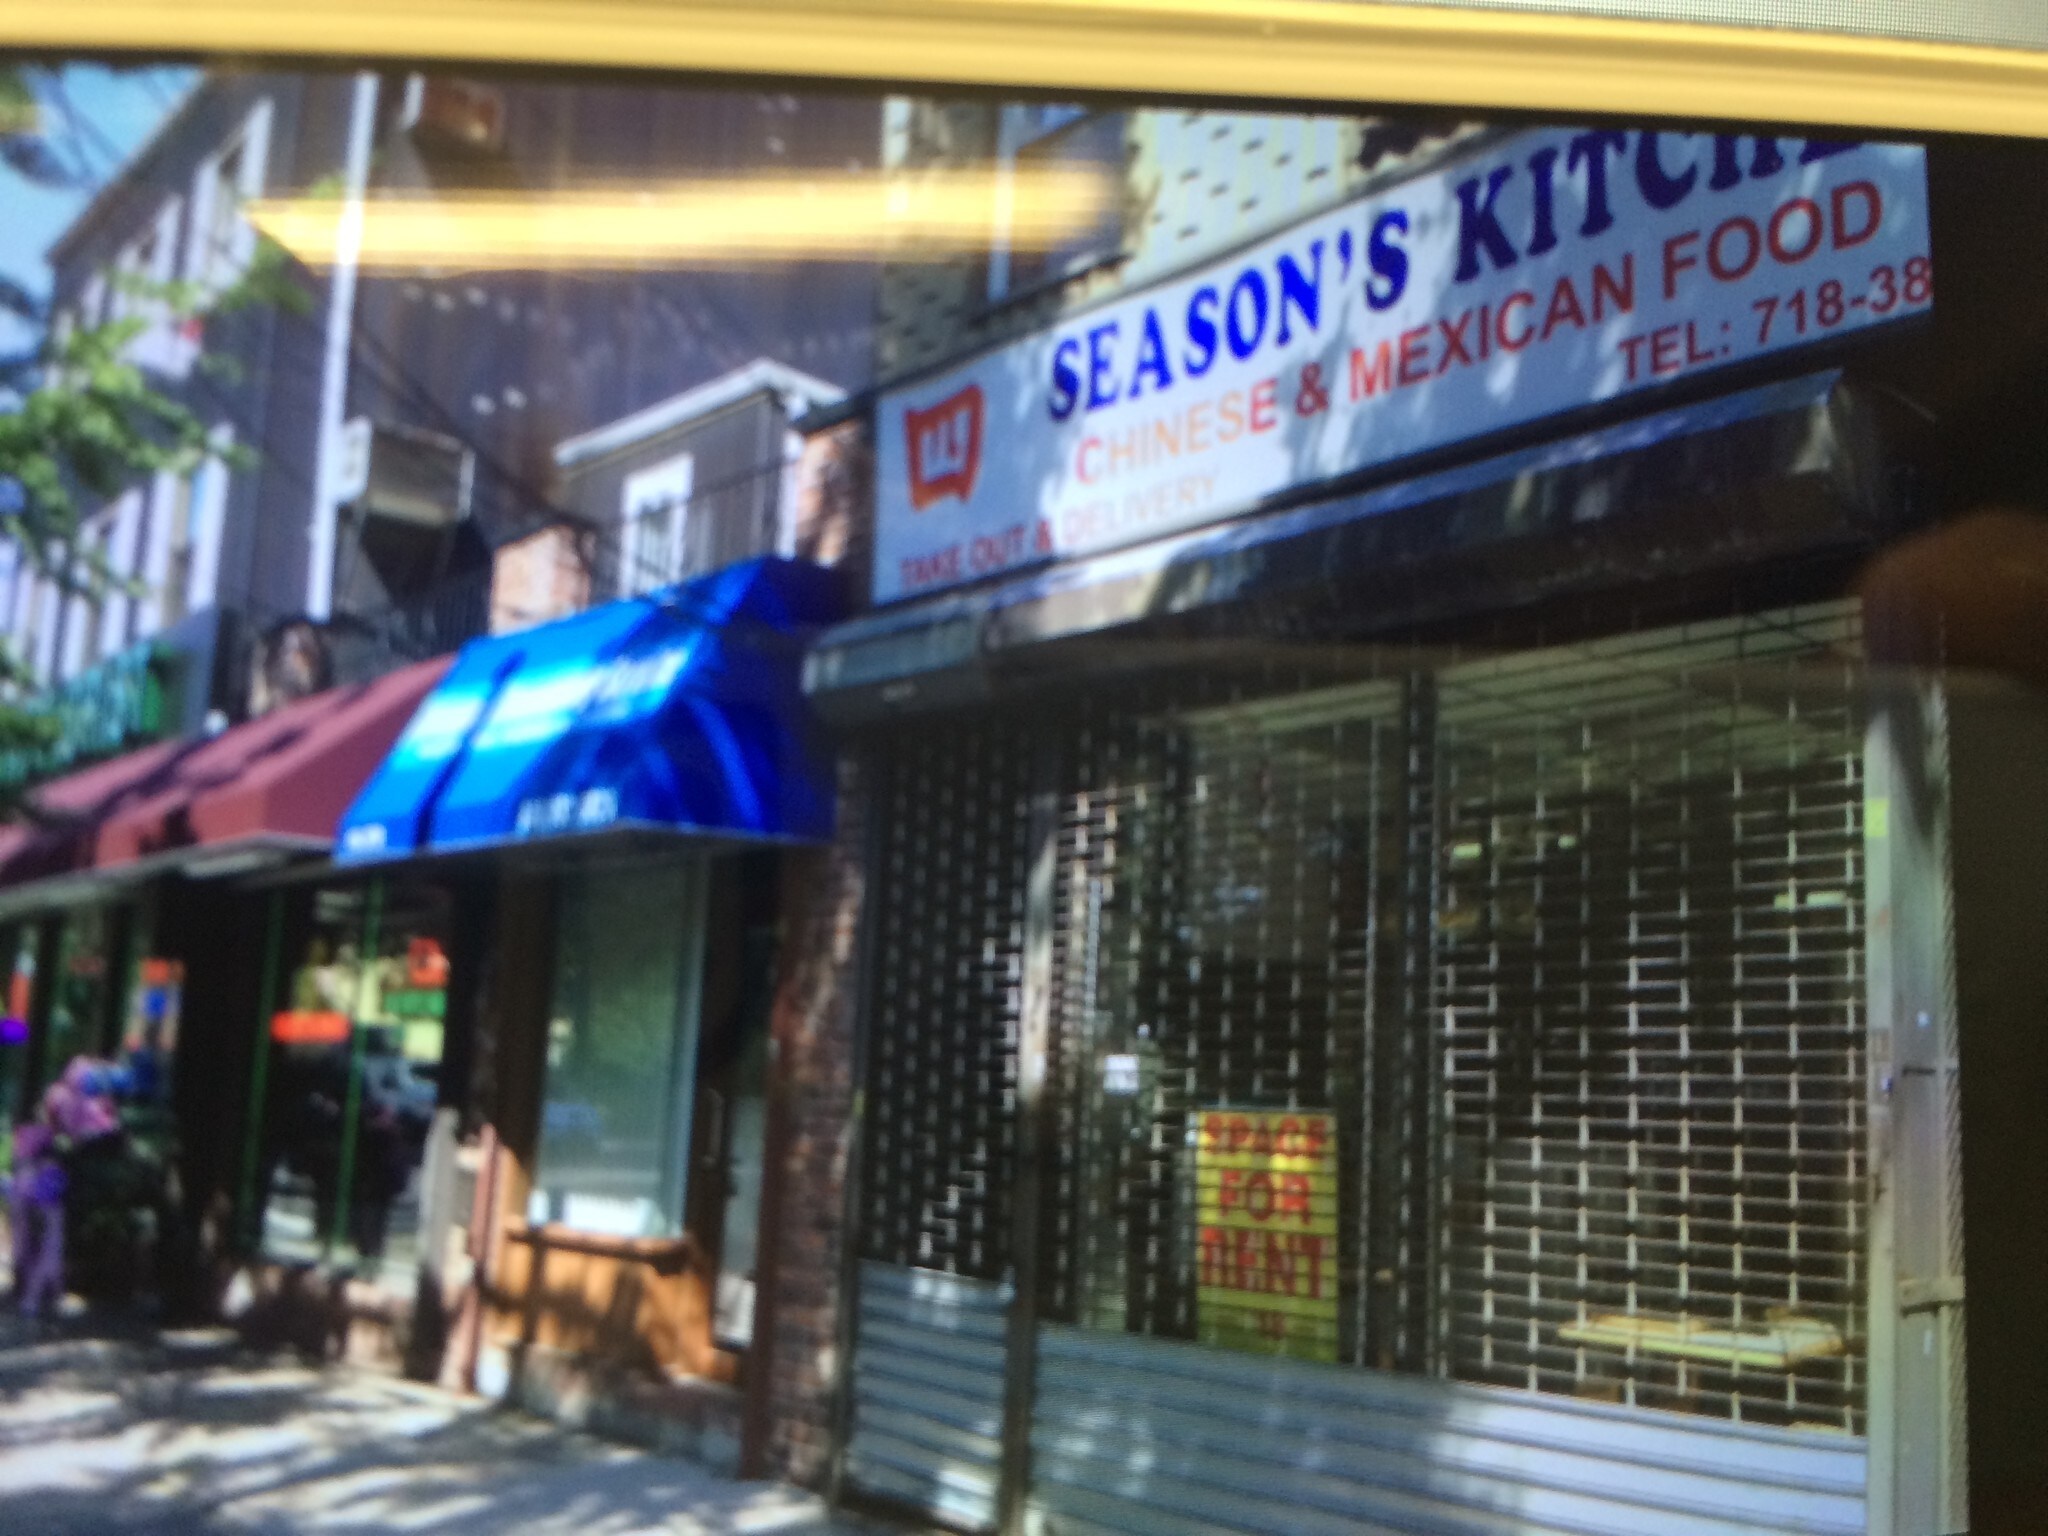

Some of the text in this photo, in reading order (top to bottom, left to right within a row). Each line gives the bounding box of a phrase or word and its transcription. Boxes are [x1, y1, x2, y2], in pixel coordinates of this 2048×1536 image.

[1046, 128, 1866, 423] SEASON'S KITC
[1076, 179, 1884, 485] CHINESE & MEXICAN FOOD
[1618, 254, 1933, 381] TEL: 718-38
[969, 522, 1025, 574] OUT
[1219, 1169, 1312, 1226] FOR
